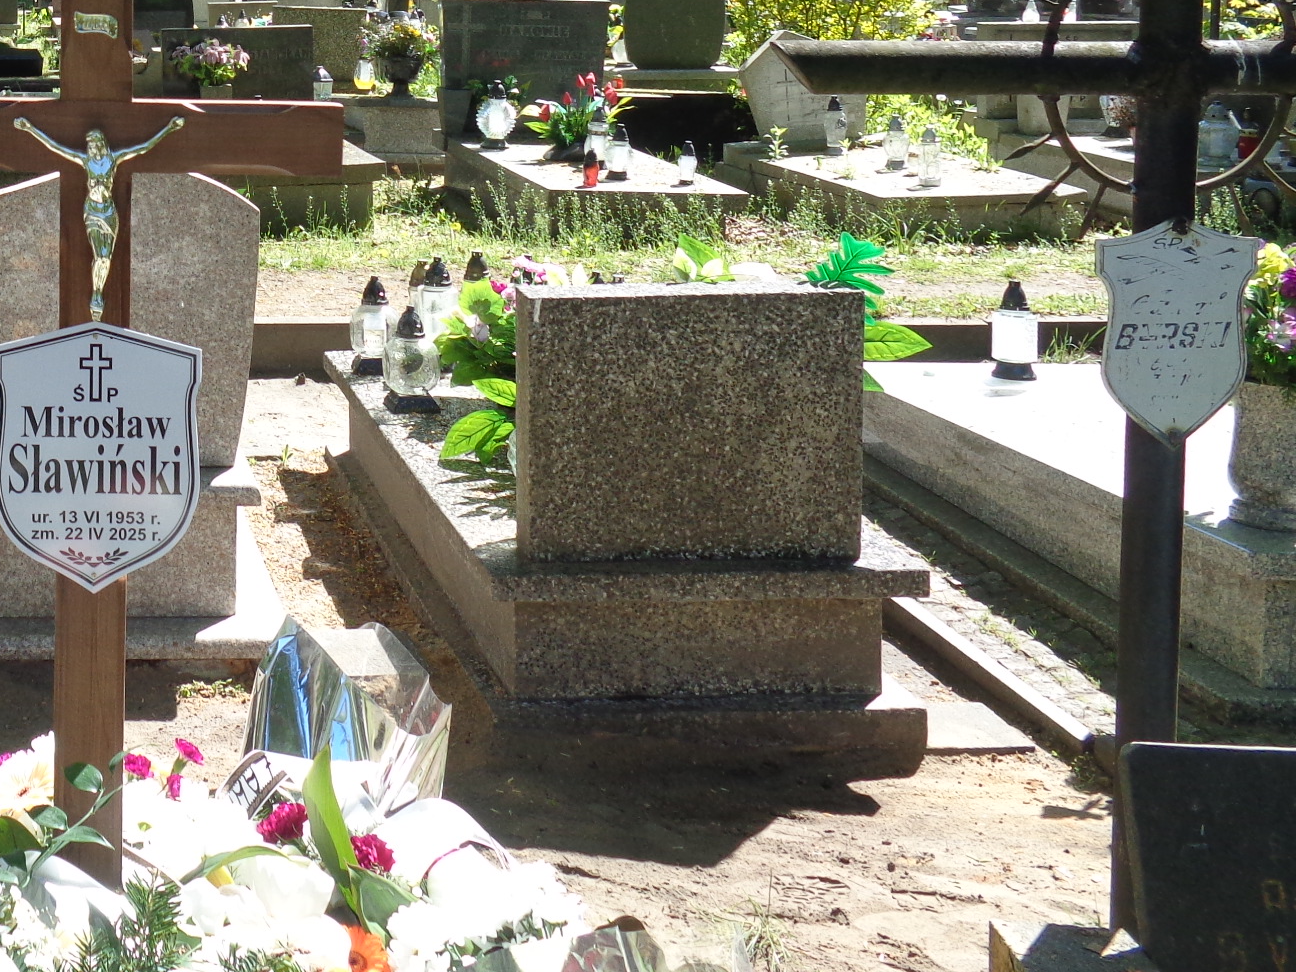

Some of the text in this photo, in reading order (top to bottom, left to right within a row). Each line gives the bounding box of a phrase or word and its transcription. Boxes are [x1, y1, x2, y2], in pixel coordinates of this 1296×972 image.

[21, 406, 171, 439] Mirosław
[8, 443, 182, 496] Sławiński
[31, 510, 161, 525] ur. 13 VI 1953 r.
[31, 527, 161, 542] zm. 22 IV 2025 r.
